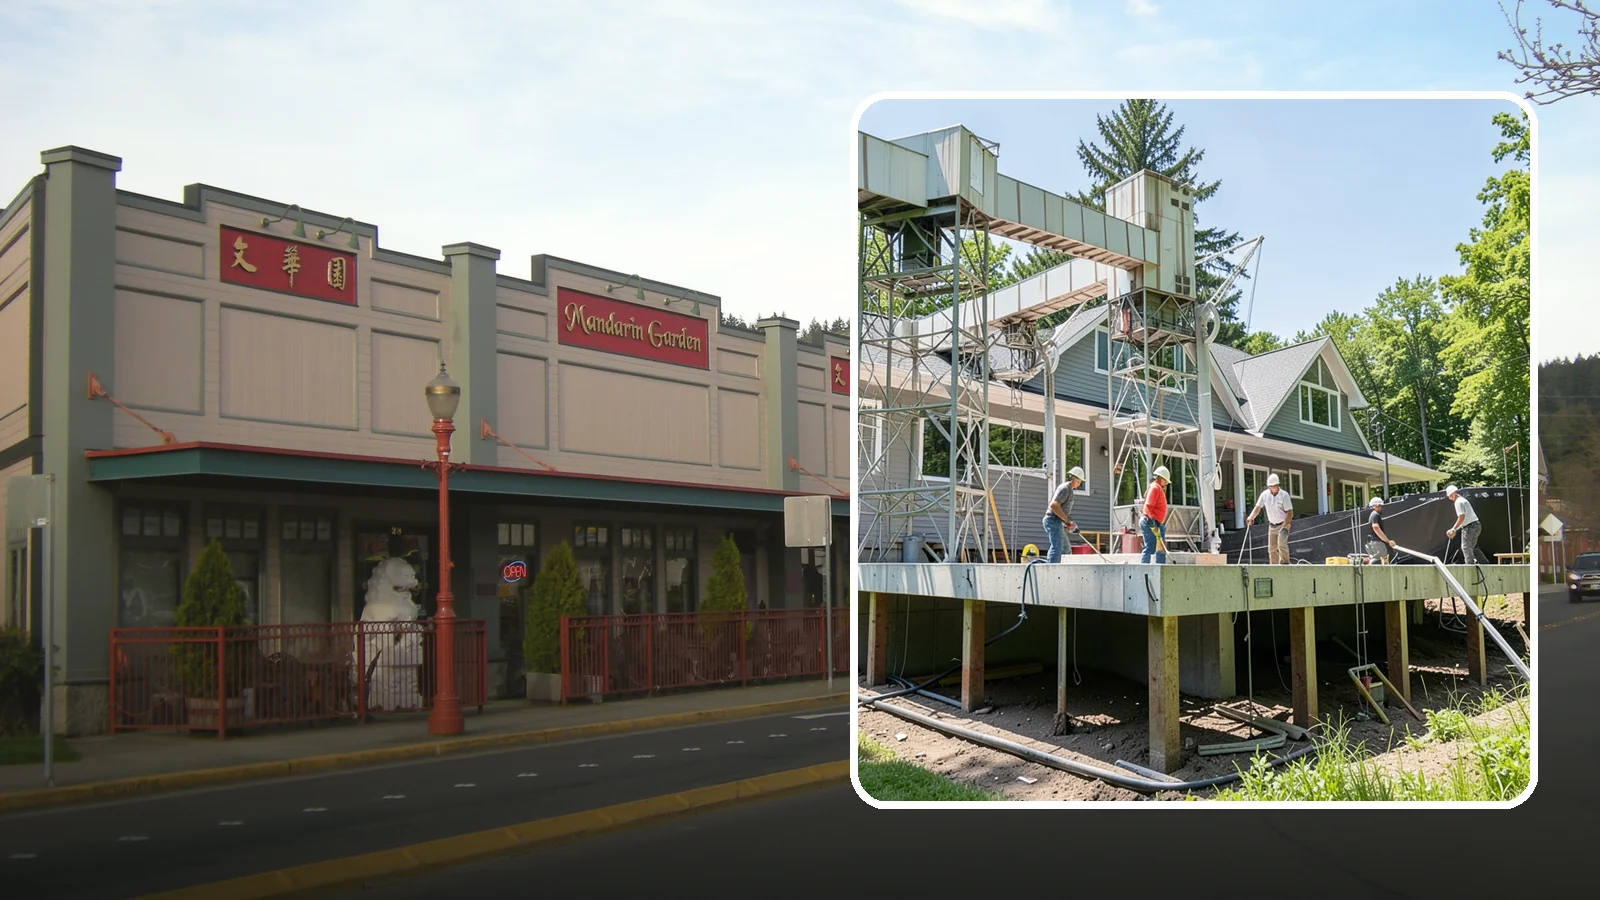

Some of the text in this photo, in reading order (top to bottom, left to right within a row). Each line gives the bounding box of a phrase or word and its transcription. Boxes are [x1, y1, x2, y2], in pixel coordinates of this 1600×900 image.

[231, 235, 346, 291] 文華園
[564, 302, 702, 352] Mandarin Garden
[834, 363, 846, 386] 文
[503, 565, 527, 578] OPEN
